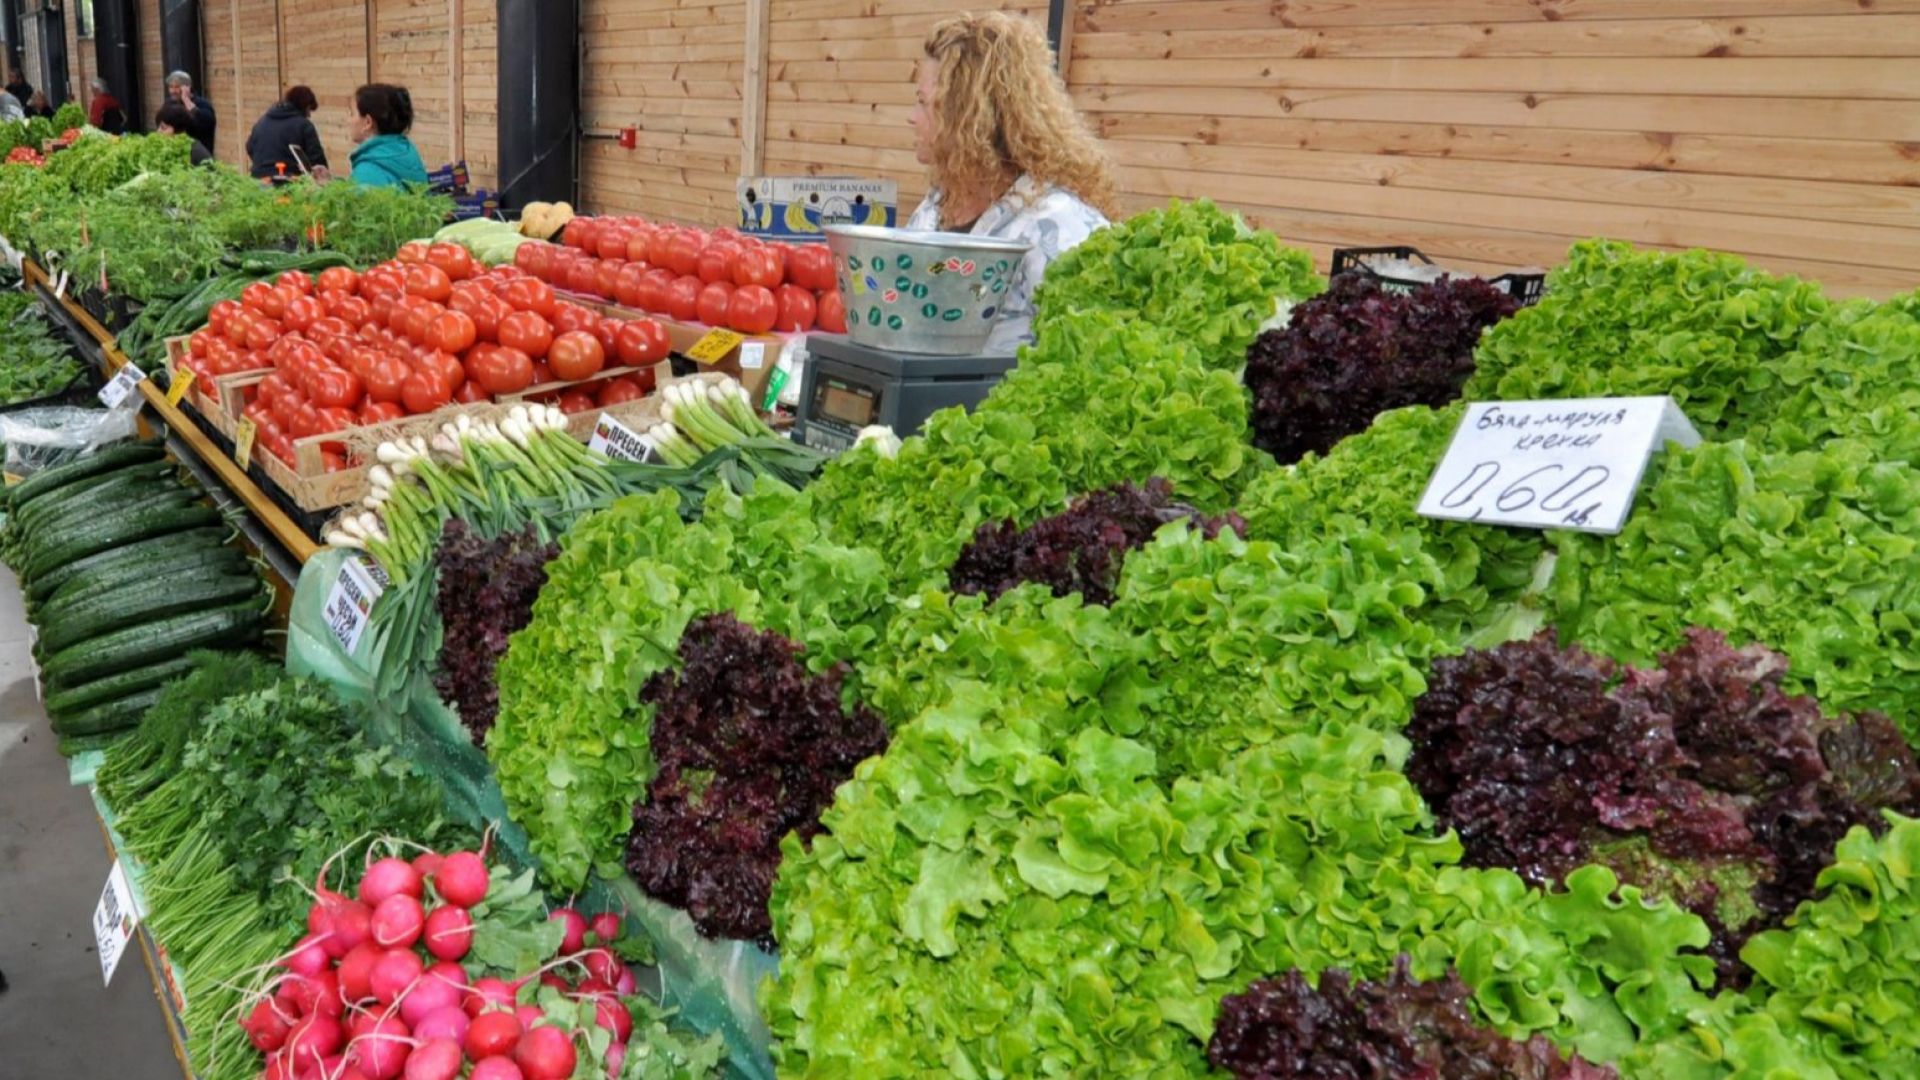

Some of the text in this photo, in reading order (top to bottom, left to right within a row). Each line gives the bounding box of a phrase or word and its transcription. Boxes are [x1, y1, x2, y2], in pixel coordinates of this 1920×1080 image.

[793, 182, 882, 193] PREMIUM BANANAS
[608, 425, 647, 462] ПРЕСЕН
